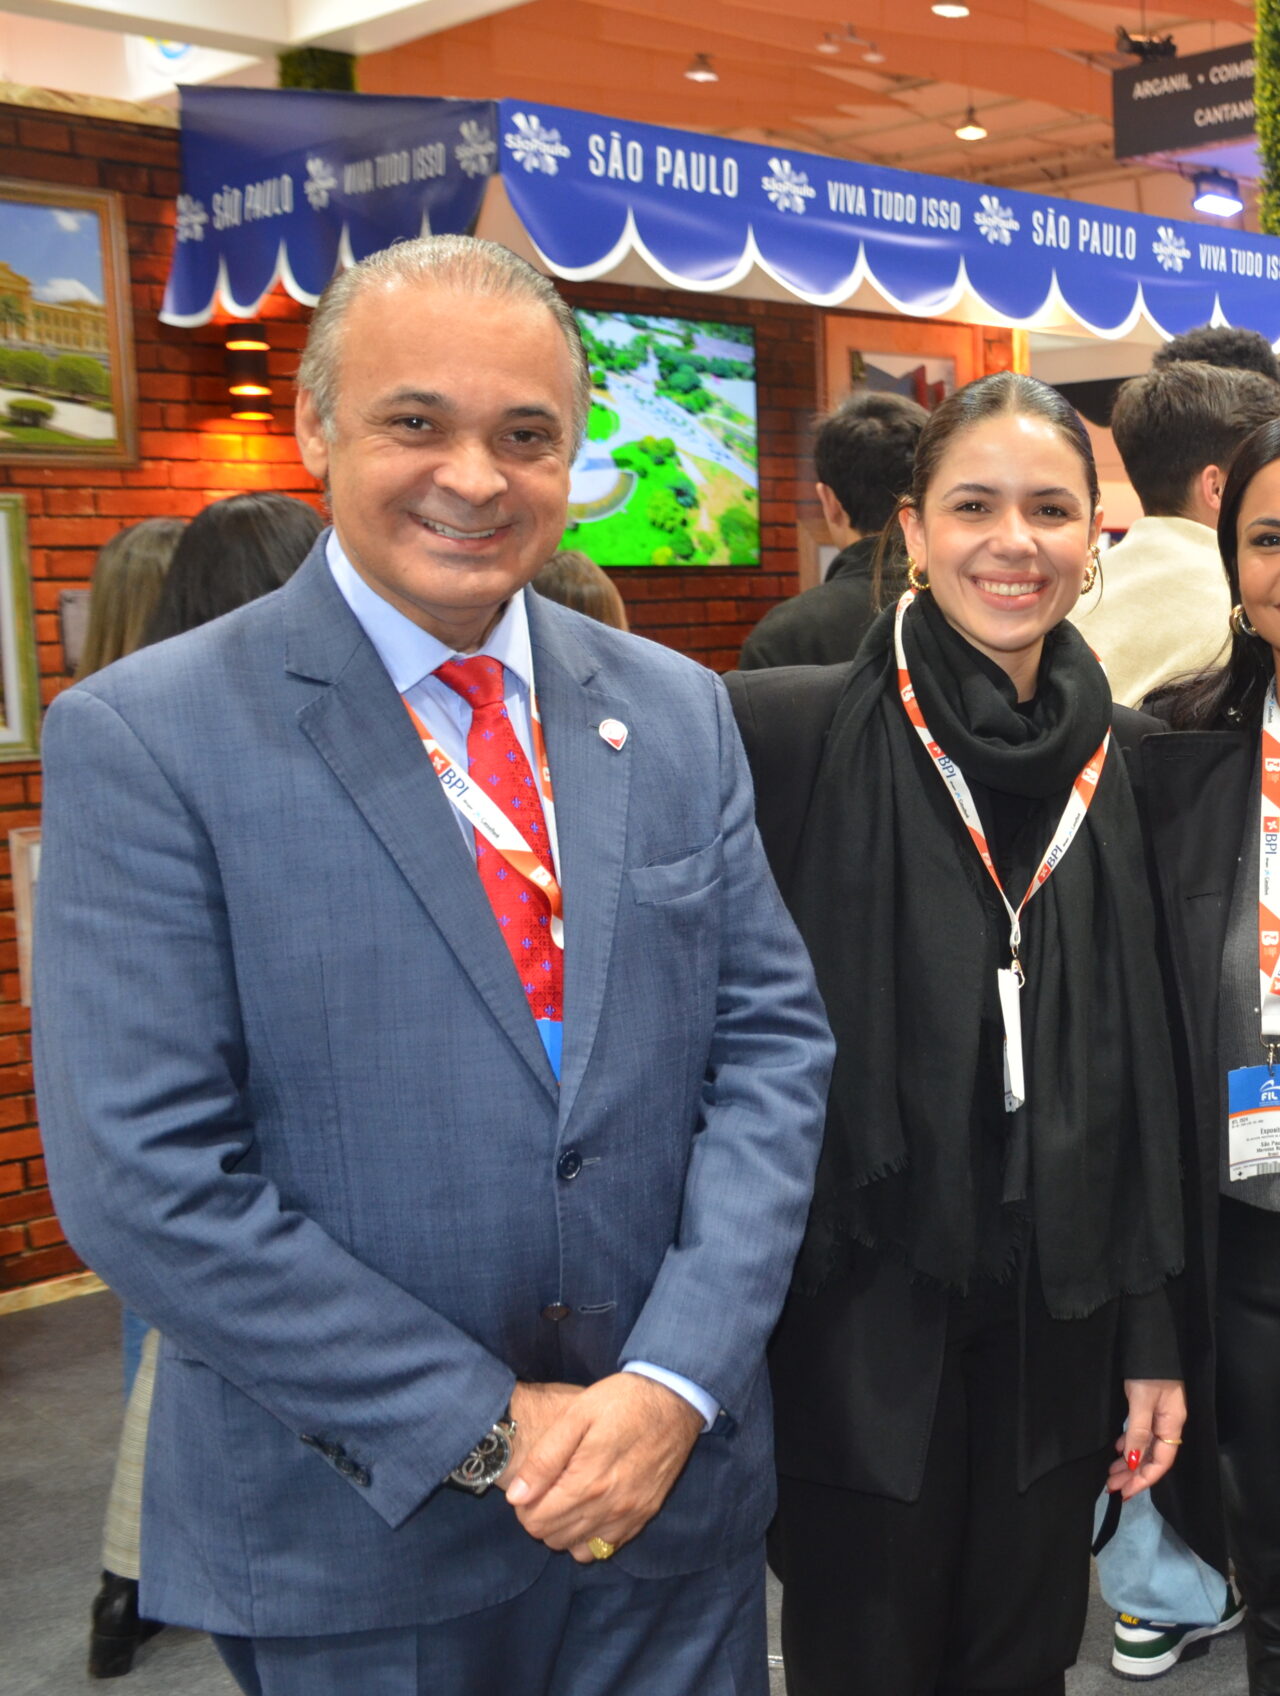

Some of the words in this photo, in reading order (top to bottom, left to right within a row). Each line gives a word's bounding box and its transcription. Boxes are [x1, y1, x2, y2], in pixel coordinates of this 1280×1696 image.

[1132, 73, 1192, 100] ARGANIL
[1209, 59, 1255, 85] COIMB
[1194, 99, 1255, 127] CANTAN
[588, 131, 643, 184] SÃO
[656, 145, 738, 198] PAULO
[245, 174, 294, 222] PAULO
[827, 180, 867, 216] VIVA
[872, 188, 917, 225] TUDO
[922, 197, 961, 231] ISSO
[1032, 208, 1070, 250] SÃO
[1078, 218, 1136, 260] PAULO
[1199, 243, 1227, 272] VIVA
[1231, 249, 1262, 278] TUDO
[439, 768, 469, 797] BPI
[938, 755, 956, 778] BPI
[1046, 845, 1063, 868] BPI
[1265, 834, 1277, 855] BPI
[1261, 1092, 1278, 1101] FIL
